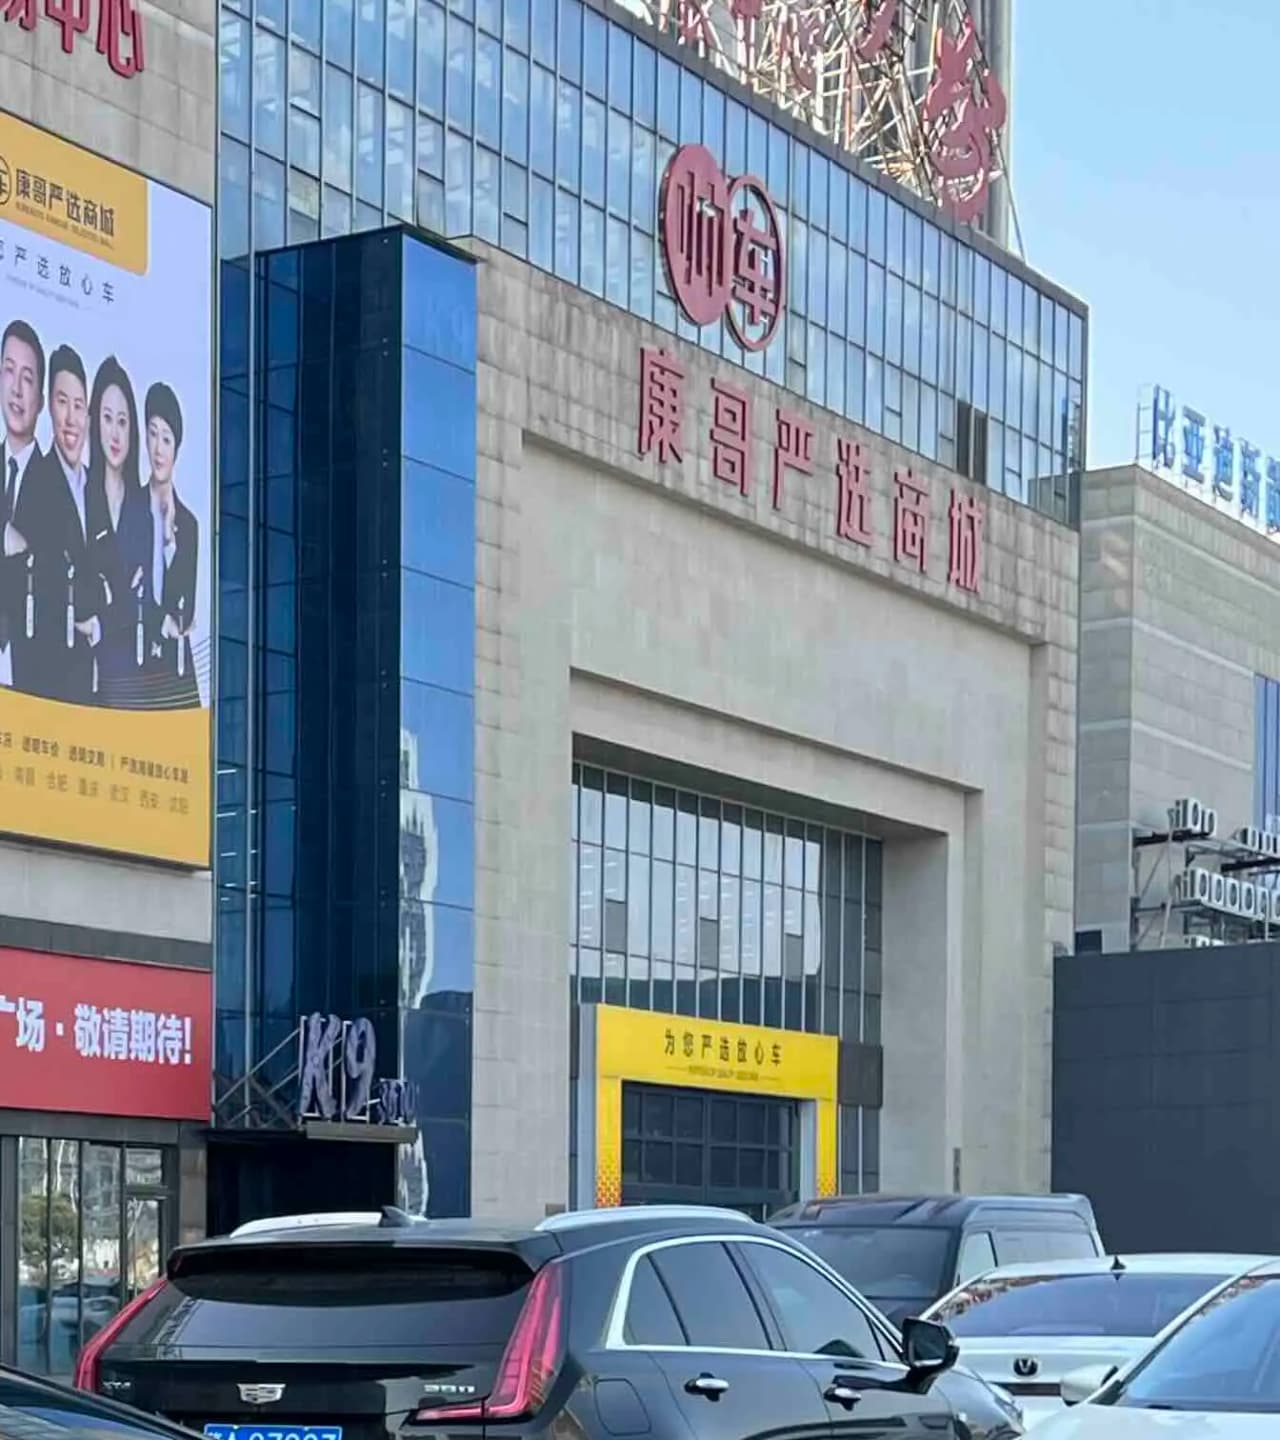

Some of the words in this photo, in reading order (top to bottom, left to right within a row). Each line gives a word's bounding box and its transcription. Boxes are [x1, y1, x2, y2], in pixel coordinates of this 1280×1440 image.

[638, 346, 985, 594] 康哥严选商城
[664, 1028, 782, 1066] 为您严选放心车
